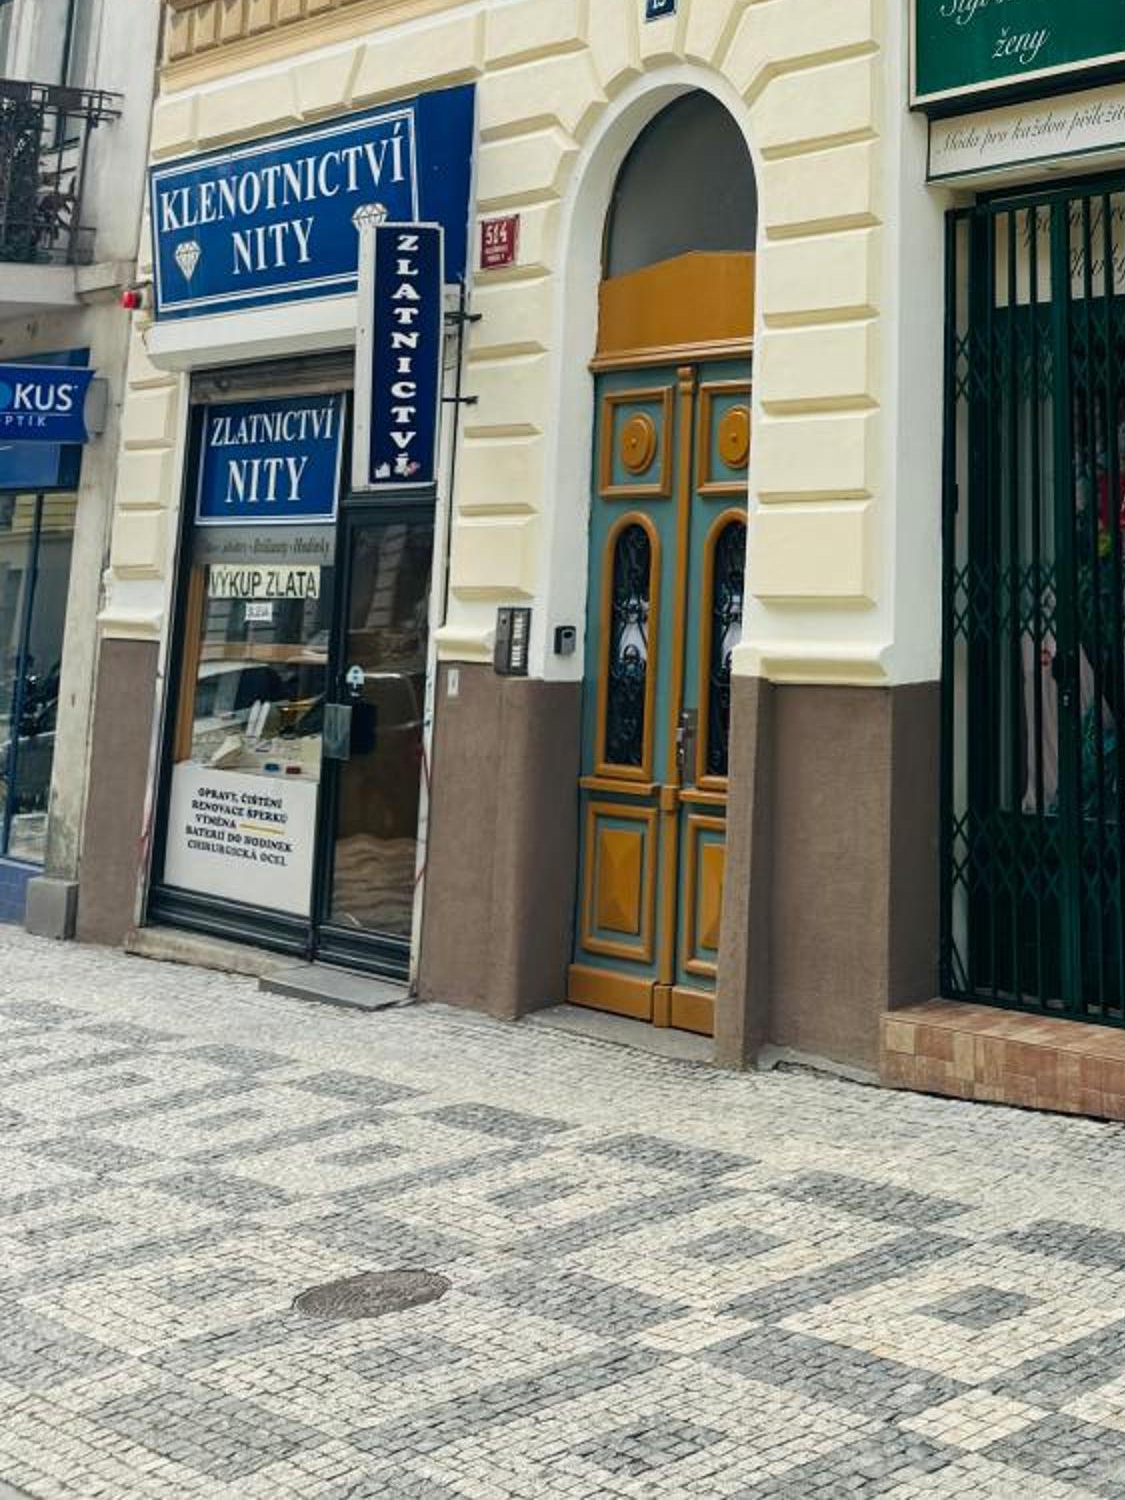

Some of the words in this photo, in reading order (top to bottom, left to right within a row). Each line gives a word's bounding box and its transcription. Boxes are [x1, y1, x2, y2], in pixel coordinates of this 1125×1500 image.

[992, 25, 1048, 65] ženy
[979, 129, 1007, 155] pro
[1009, 111, 1067, 141] každou
[160, 123, 404, 232] KLENOTNICTVÍ
[232, 217, 314, 275] NITY
[390, 234, 421, 477] ZLATNICTVÍ
[8, 382, 74, 411] KUS
[210, 399, 335, 447] ZLATNICTVÍ
[225, 456, 308, 503] NITY
[210, 566, 262, 597] VÝKUP
[265, 571, 317, 597] ZLATA
[227, 833, 242, 843] DO
